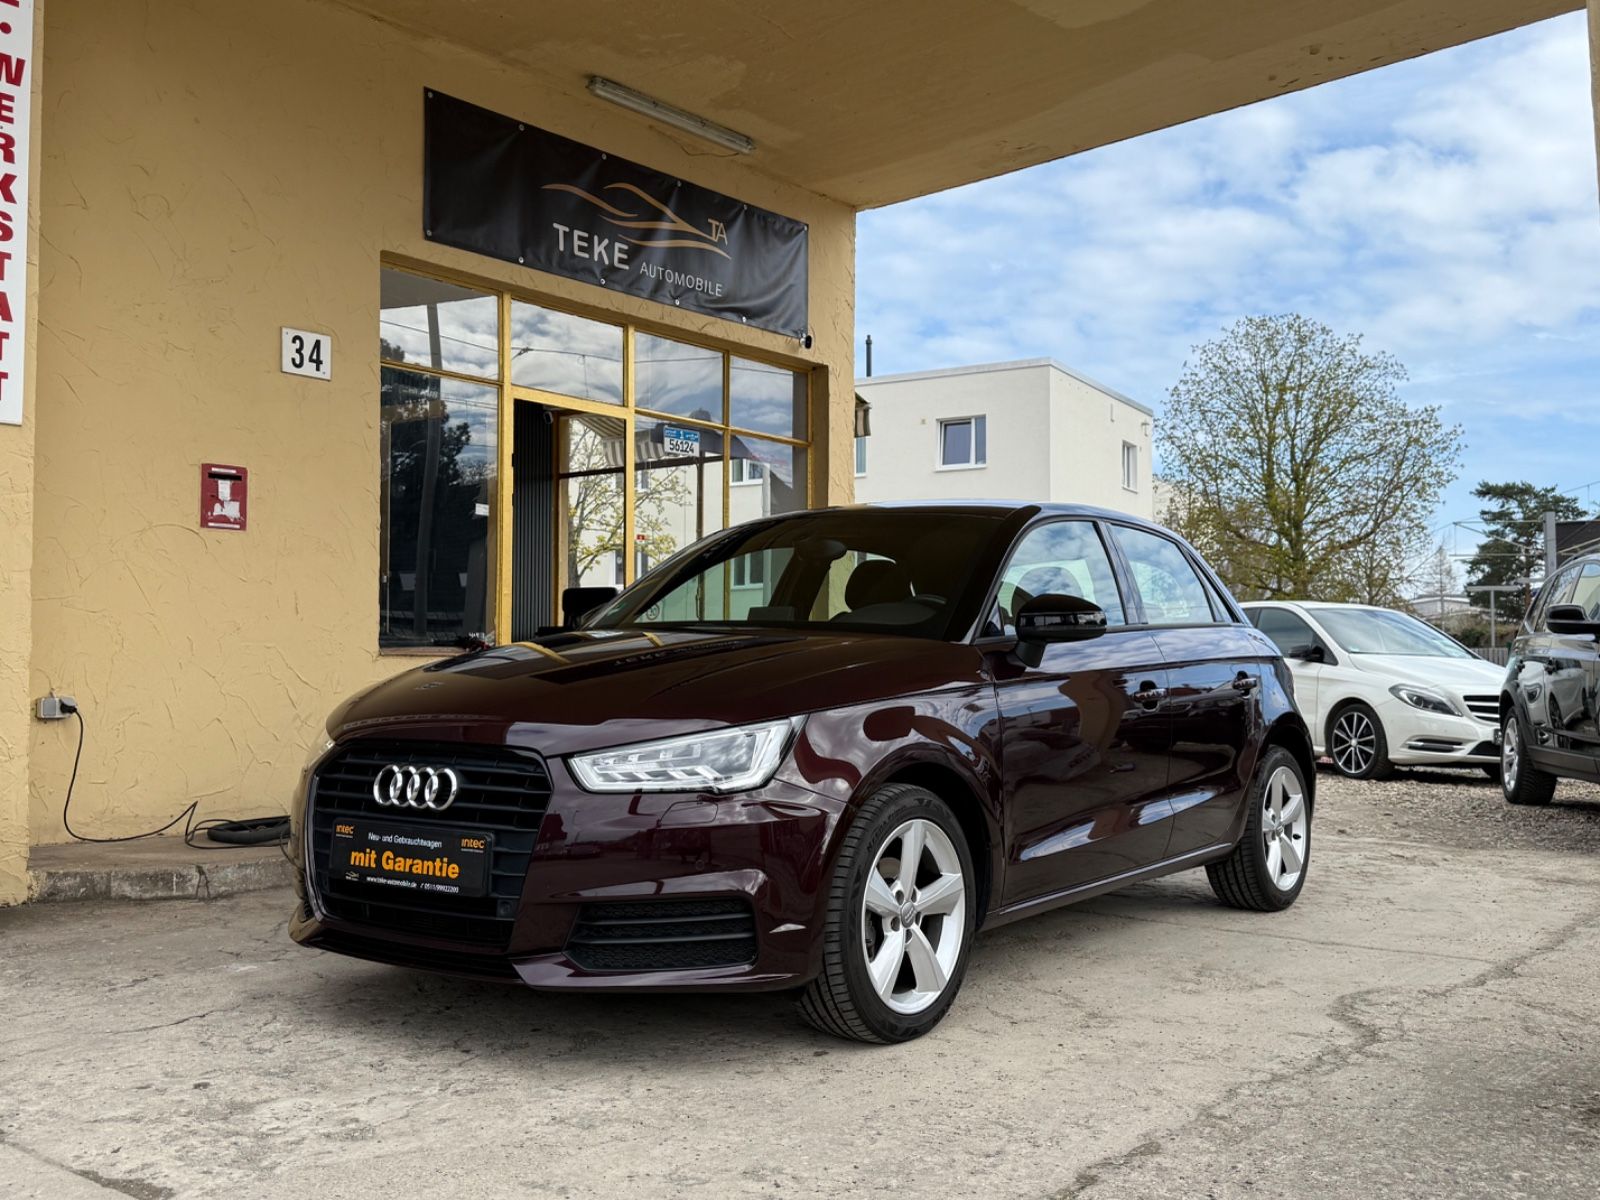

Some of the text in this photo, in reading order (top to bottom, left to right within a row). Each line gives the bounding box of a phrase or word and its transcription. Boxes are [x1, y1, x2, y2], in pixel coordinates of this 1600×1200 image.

[552, 222, 630, 270] TEKE
[639, 261, 723, 297] AUTOMOBILE
[291, 334, 323, 372] 34
[669, 438, 694, 454] 56124
[461, 838, 485, 849] intec
[350, 849, 460, 878] mit Garantie
